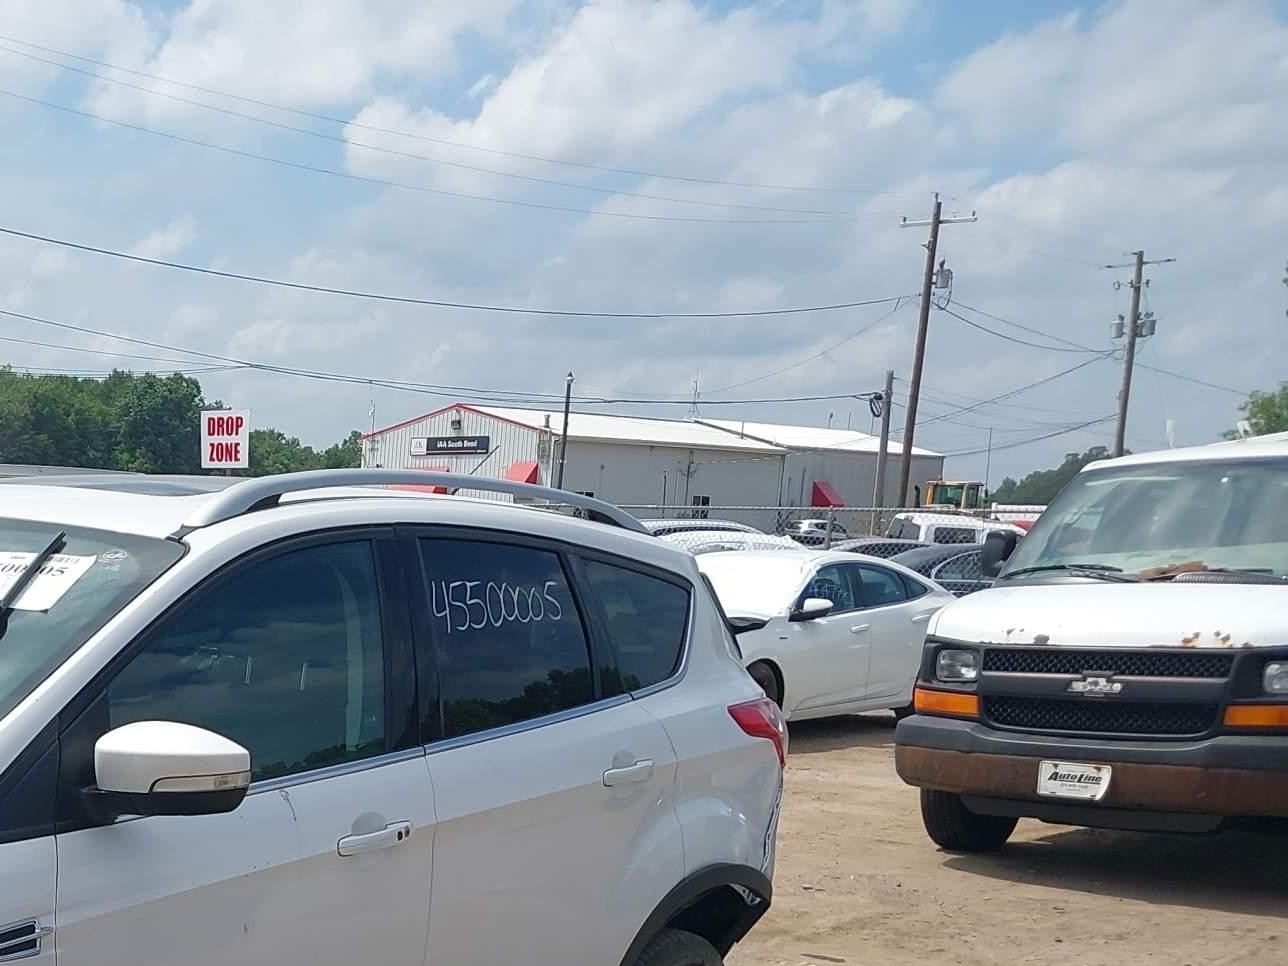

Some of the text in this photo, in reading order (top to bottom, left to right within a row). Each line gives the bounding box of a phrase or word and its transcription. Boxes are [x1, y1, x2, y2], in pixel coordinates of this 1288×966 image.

[207, 416, 244, 436] DROP
[209, 442, 241, 462] ZONE
[431, 580, 562, 634] 45500005
